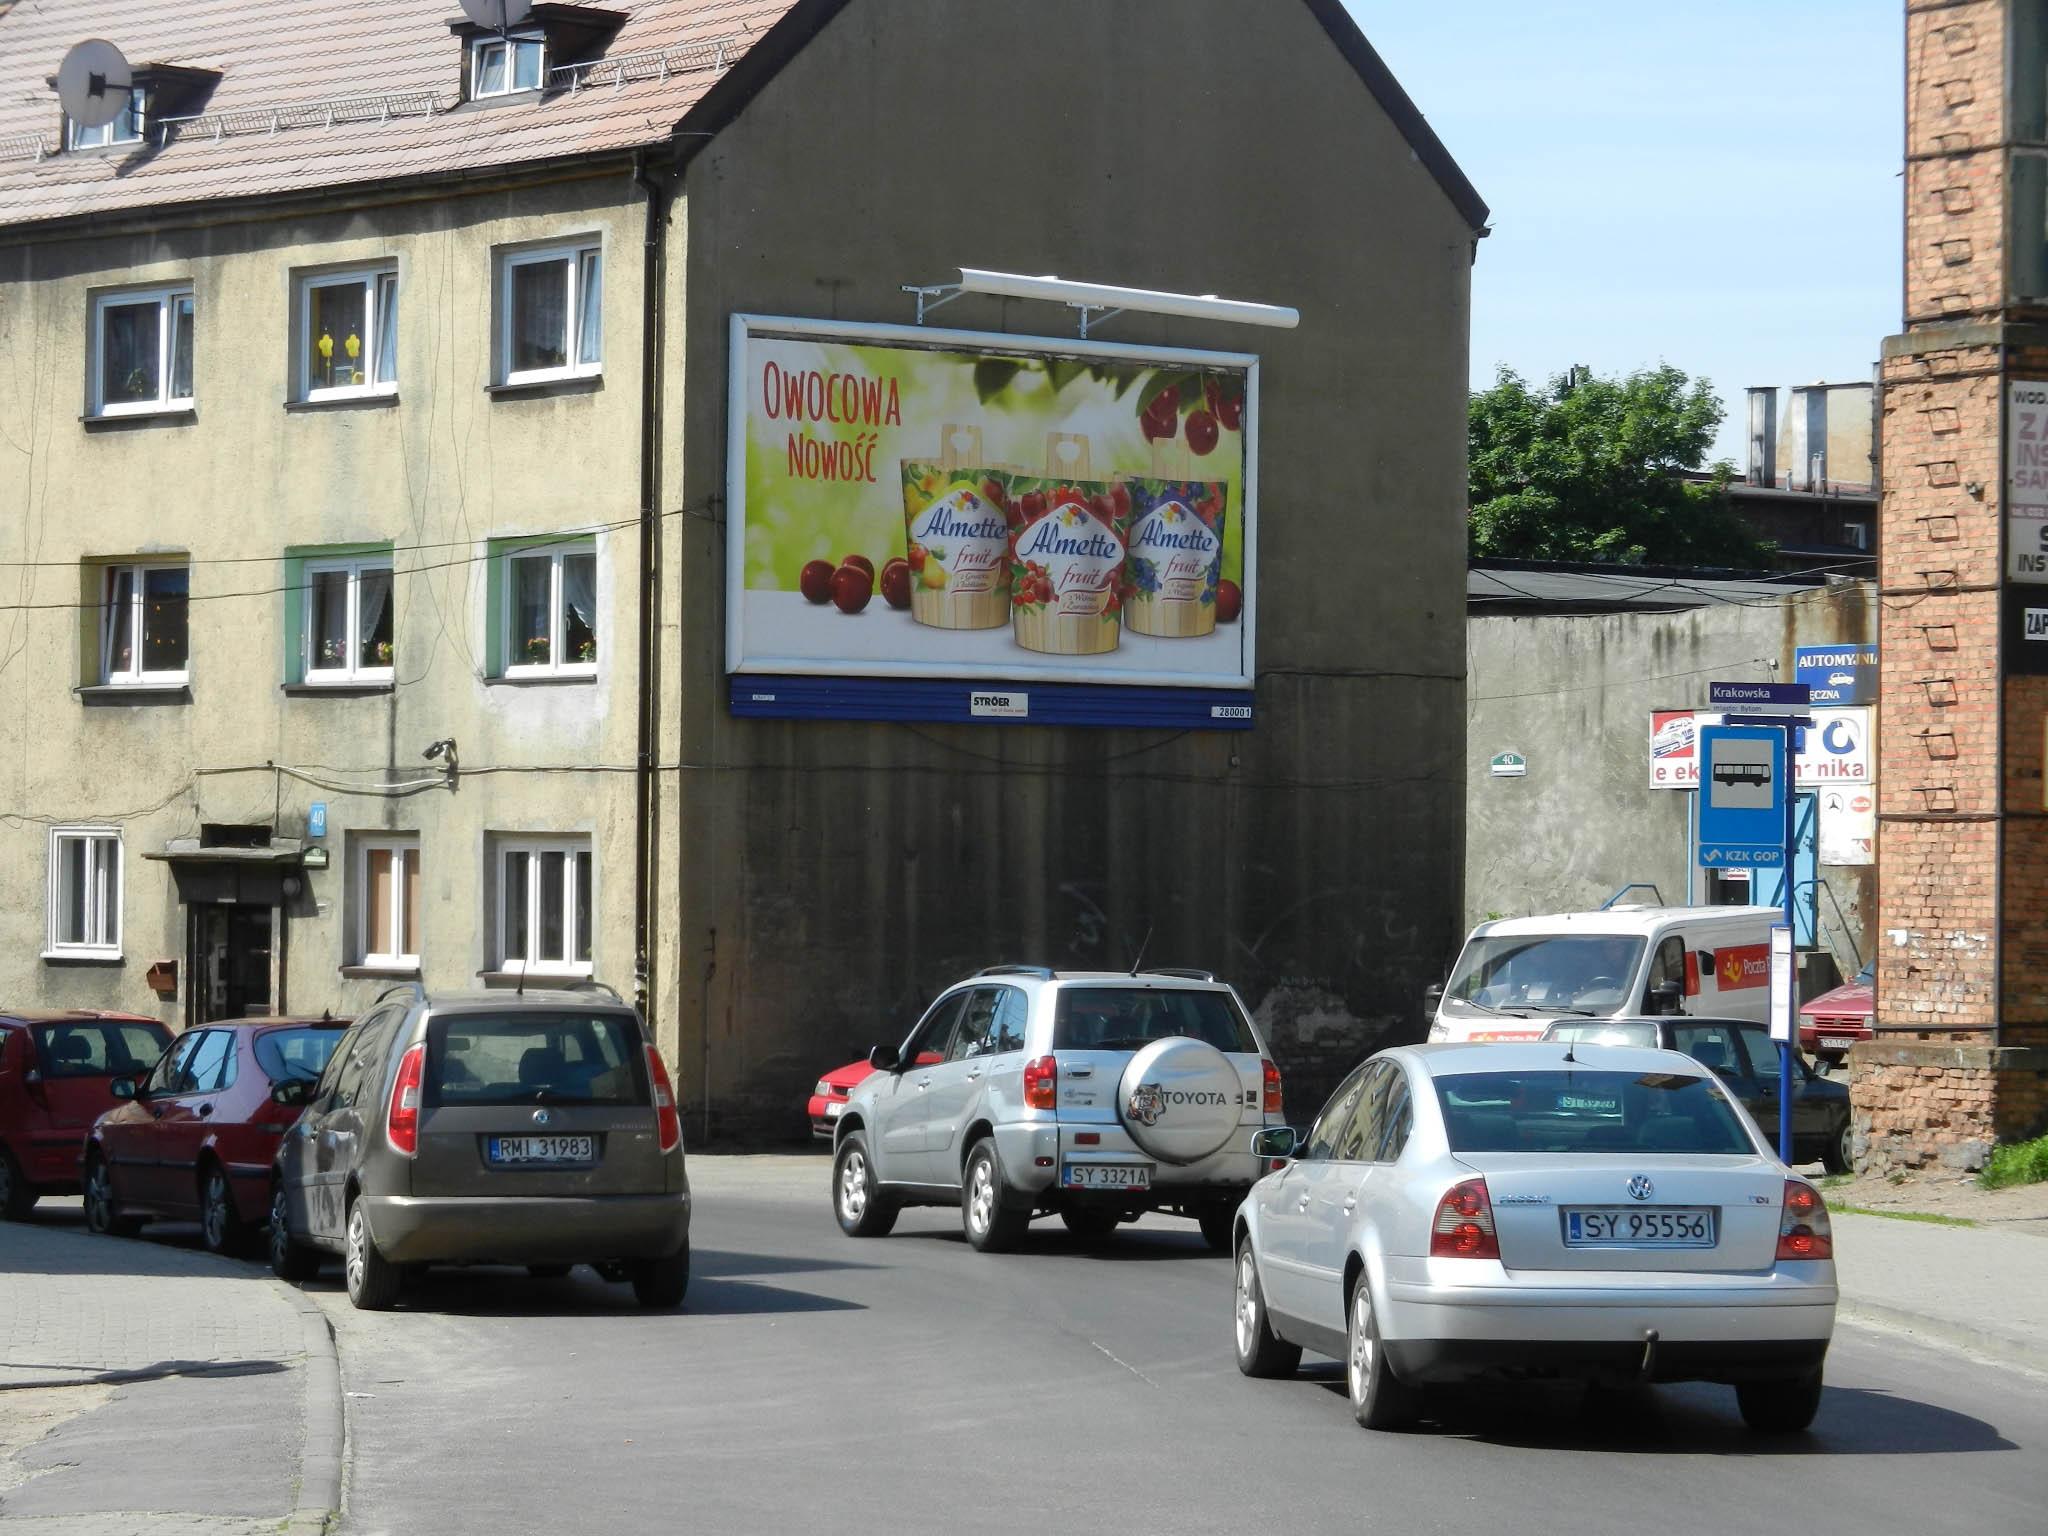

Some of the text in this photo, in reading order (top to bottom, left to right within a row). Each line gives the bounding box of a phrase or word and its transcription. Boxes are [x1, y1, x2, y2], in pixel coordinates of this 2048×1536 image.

[763, 360, 901, 427] OWOCOWA
[788, 431, 878, 483] NOWOŚĆ
[917, 507, 1008, 539] Almette
[1020, 521, 1117, 559] Almette
[1129, 518, 1213, 551] Almette
[952, 544, 991, 571] fruit
[1164, 553, 1201, 579] fruit
[2017, 553, 2048, 573] INS
[1059, 562, 1101, 590] fruit
[1713, 687, 1771, 699] Krakowska
[1808, 689, 1841, 702] ĘCZNA
[1502, 754, 1514, 765] 40
[312, 811, 324, 827] 40
[1726, 850, 1779, 862] KZK GOP
[1163, 1091, 1227, 1106] TOYOTA
[500, 1138, 591, 1157] RMI 31983
[1073, 1168, 1148, 1185] SY 3321A
[1584, 1214, 1705, 1238] SY 95556
